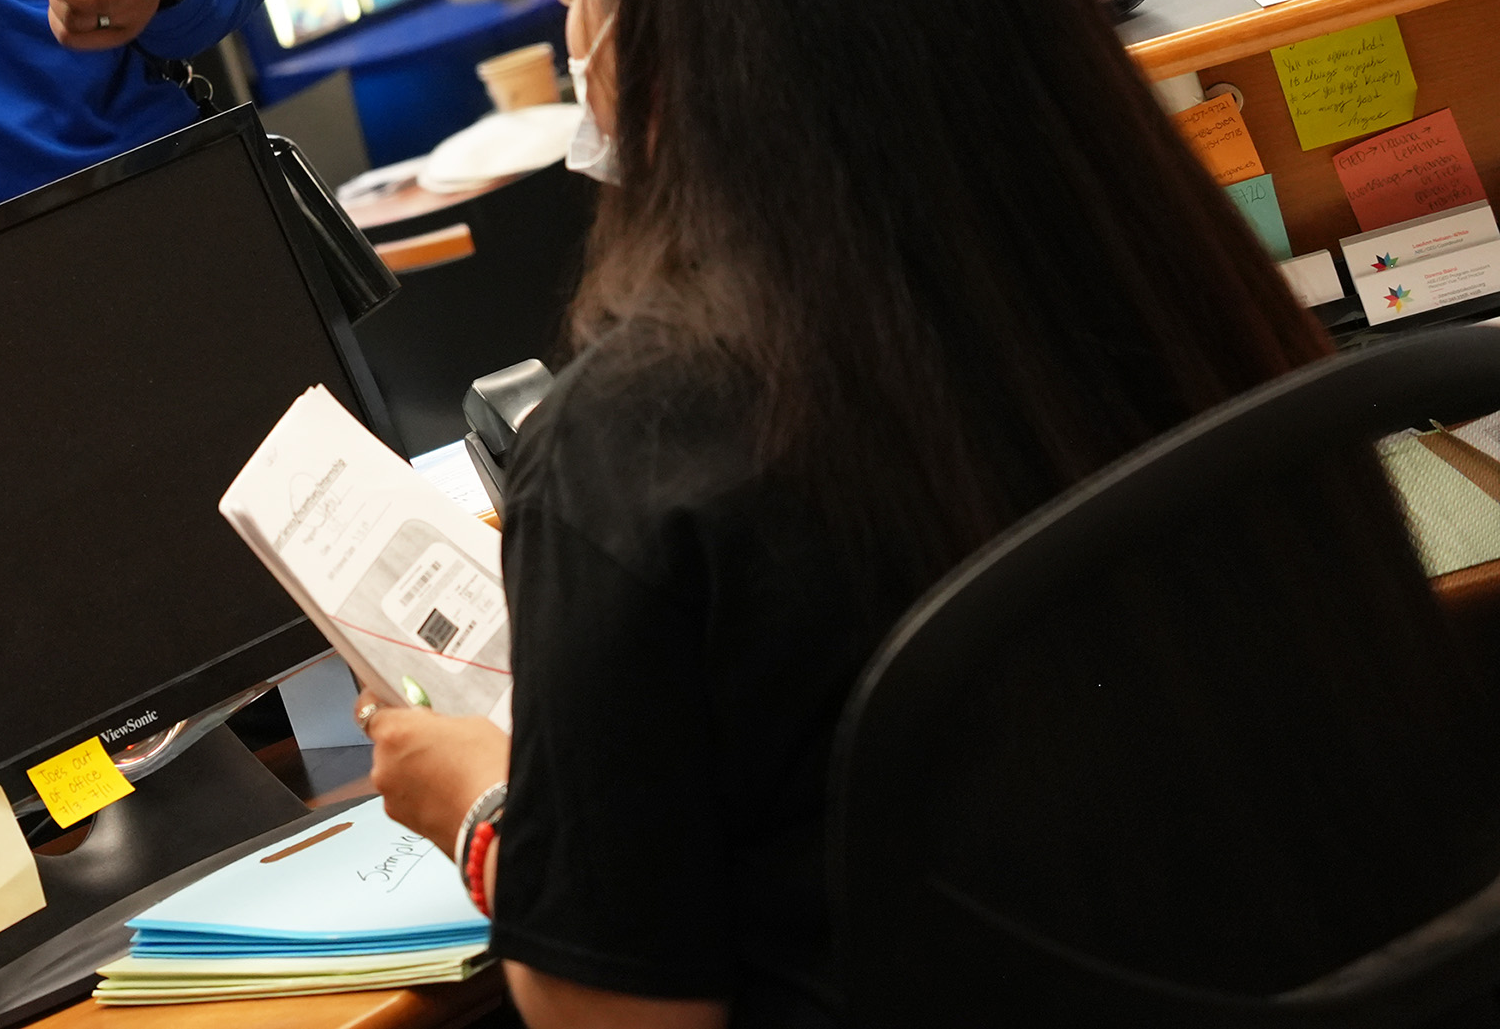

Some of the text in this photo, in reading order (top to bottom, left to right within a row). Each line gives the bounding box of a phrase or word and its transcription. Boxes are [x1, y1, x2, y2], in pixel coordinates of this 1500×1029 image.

[1323, 85, 1338, 99] you
[1339, 81, 1359, 96] guys
[100, 710, 159, 744] ViewSonic
[39, 750, 92, 785] Joe's out
[49, 769, 102, 804] of office
